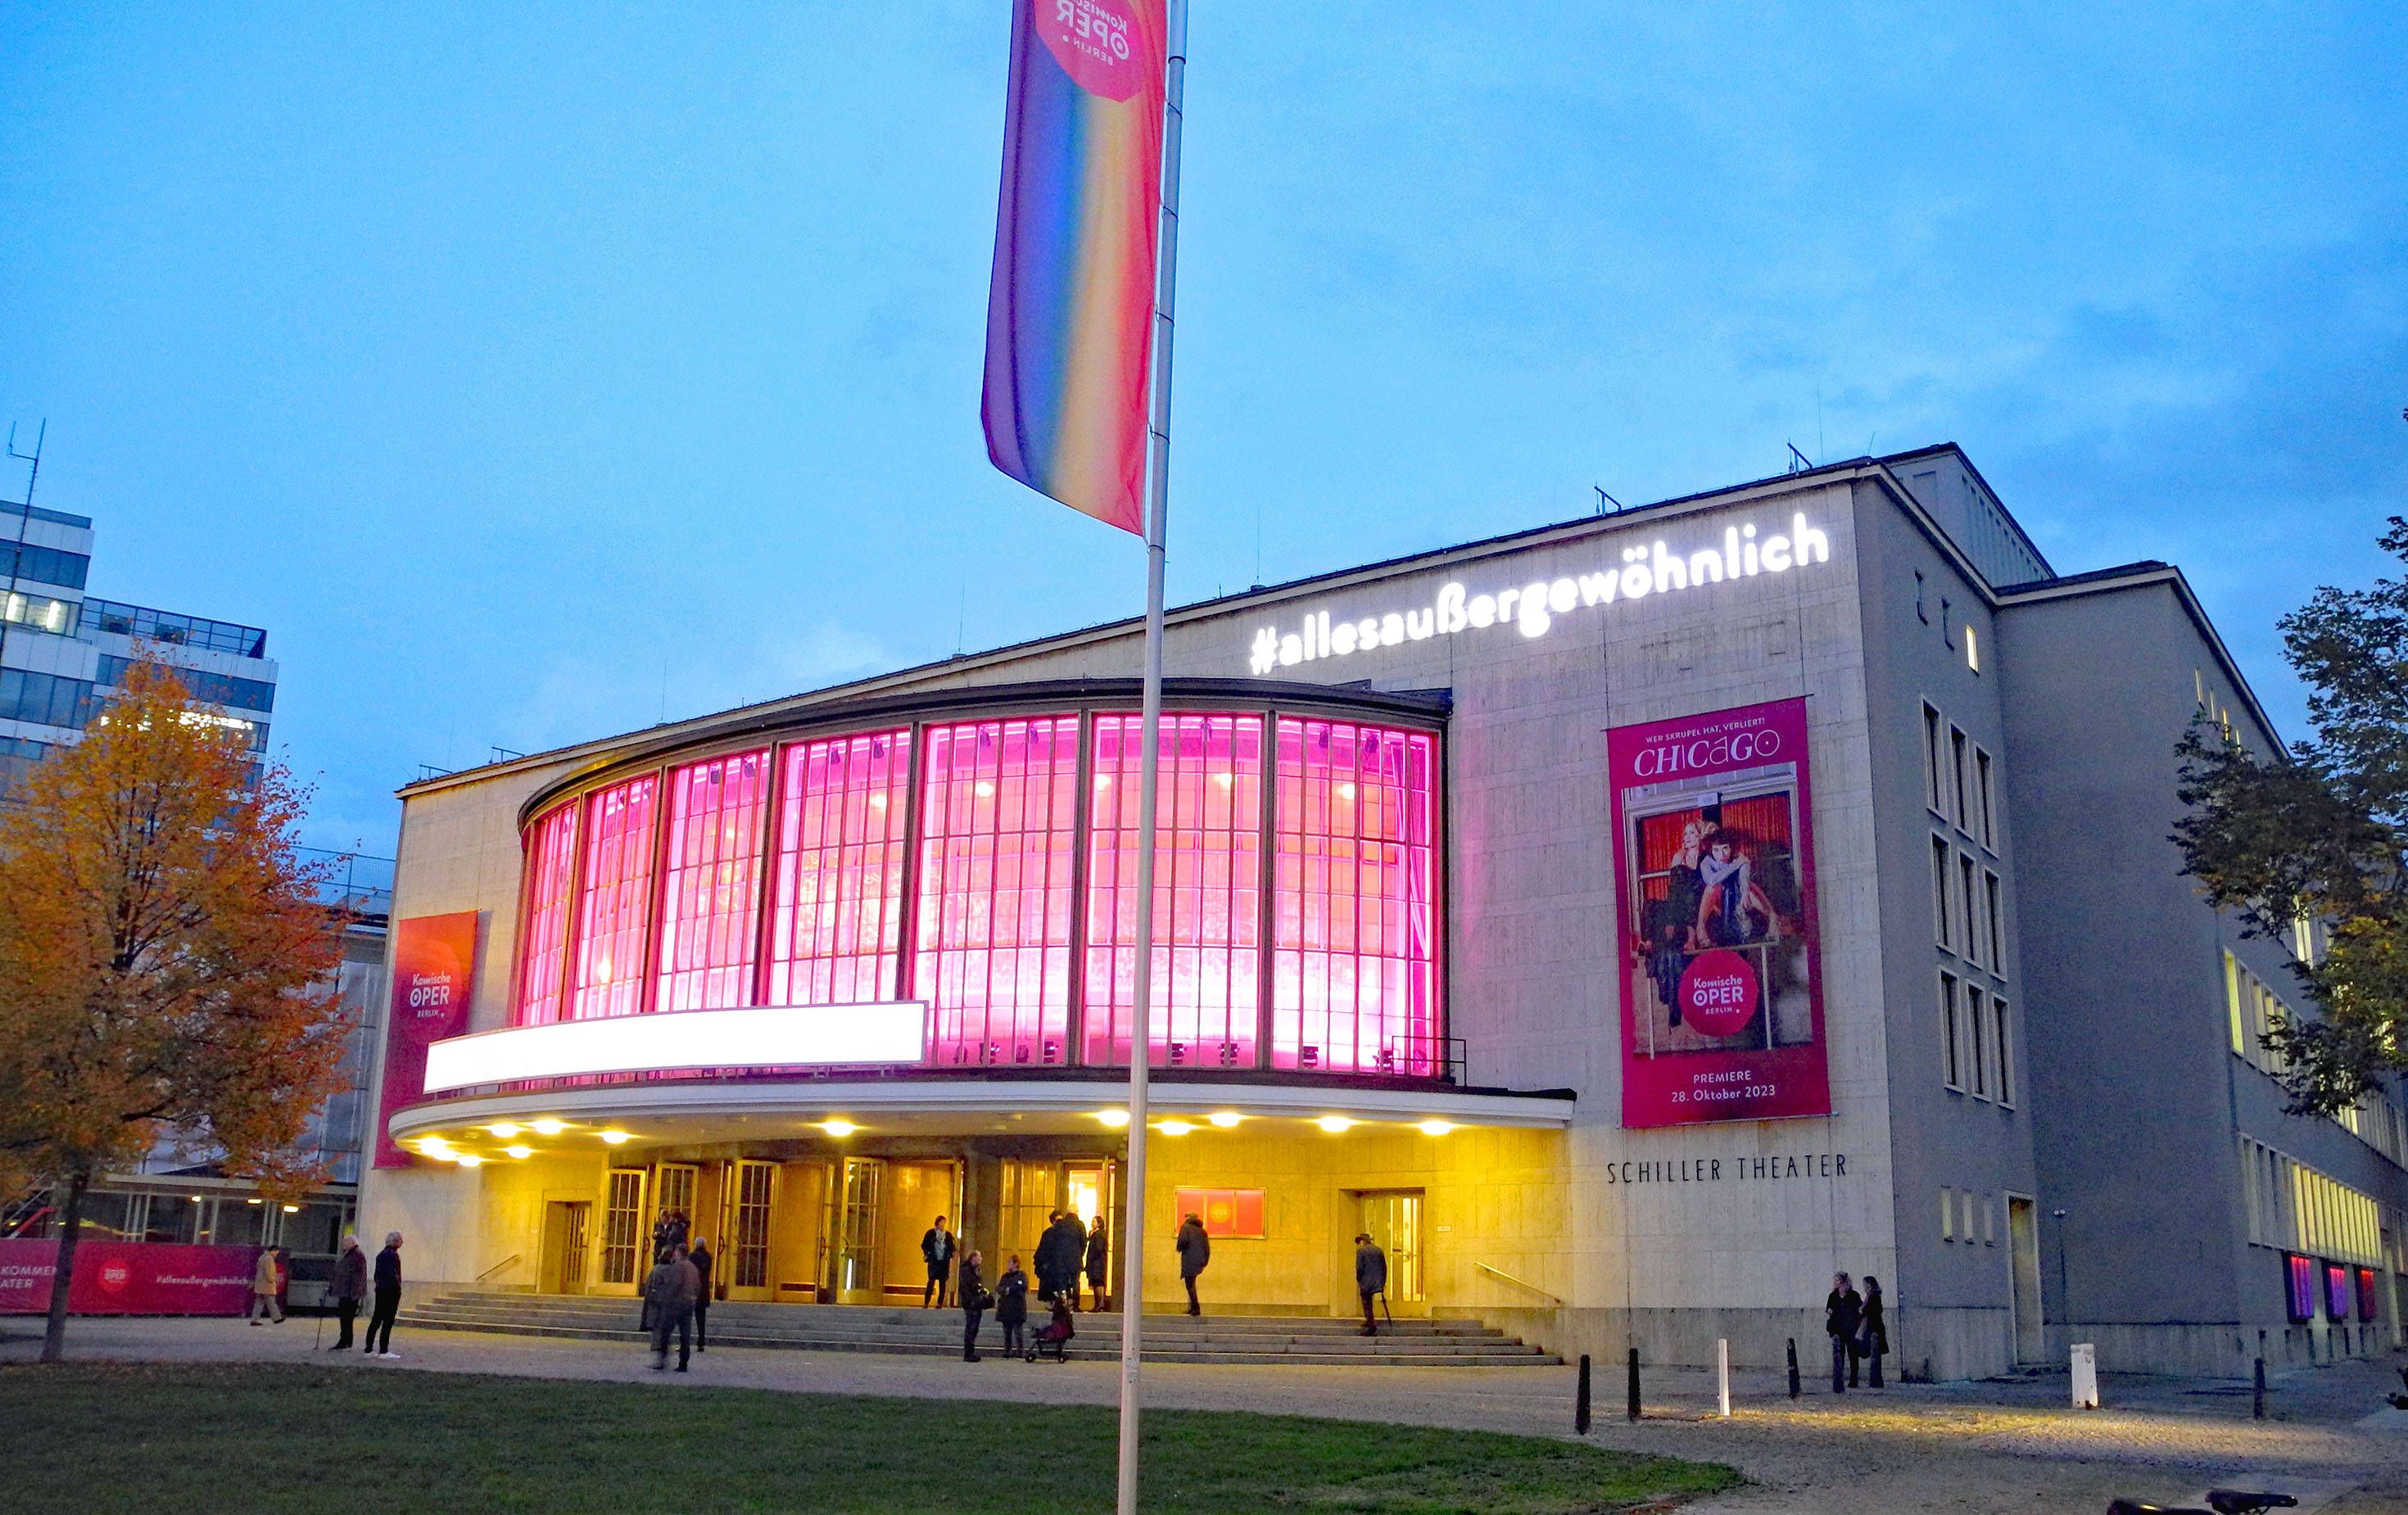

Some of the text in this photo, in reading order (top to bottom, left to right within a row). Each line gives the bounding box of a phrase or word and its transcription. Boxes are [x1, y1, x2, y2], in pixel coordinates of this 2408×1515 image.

[1250, 512, 1831, 676] #allesaußergewöhnlich
[1645, 717, 1766, 744] WER SKRUPEL HAT, VERLIERT!
[412, 970, 451, 987] Komische
[1694, 974, 1743, 989] Komische
[410, 985, 450, 1007] OPER
[1693, 986, 1744, 1006] OPER
[417, 1009, 439, 1018] BERLIN
[1705, 1006, 1732, 1015] BERLIN
[1693, 1070, 1751, 1083] PREMIERE
[1672, 1084, 1776, 1102] 28. Oktober 2023
[1607, 1153, 1846, 1184] SCHILLER THEATER
